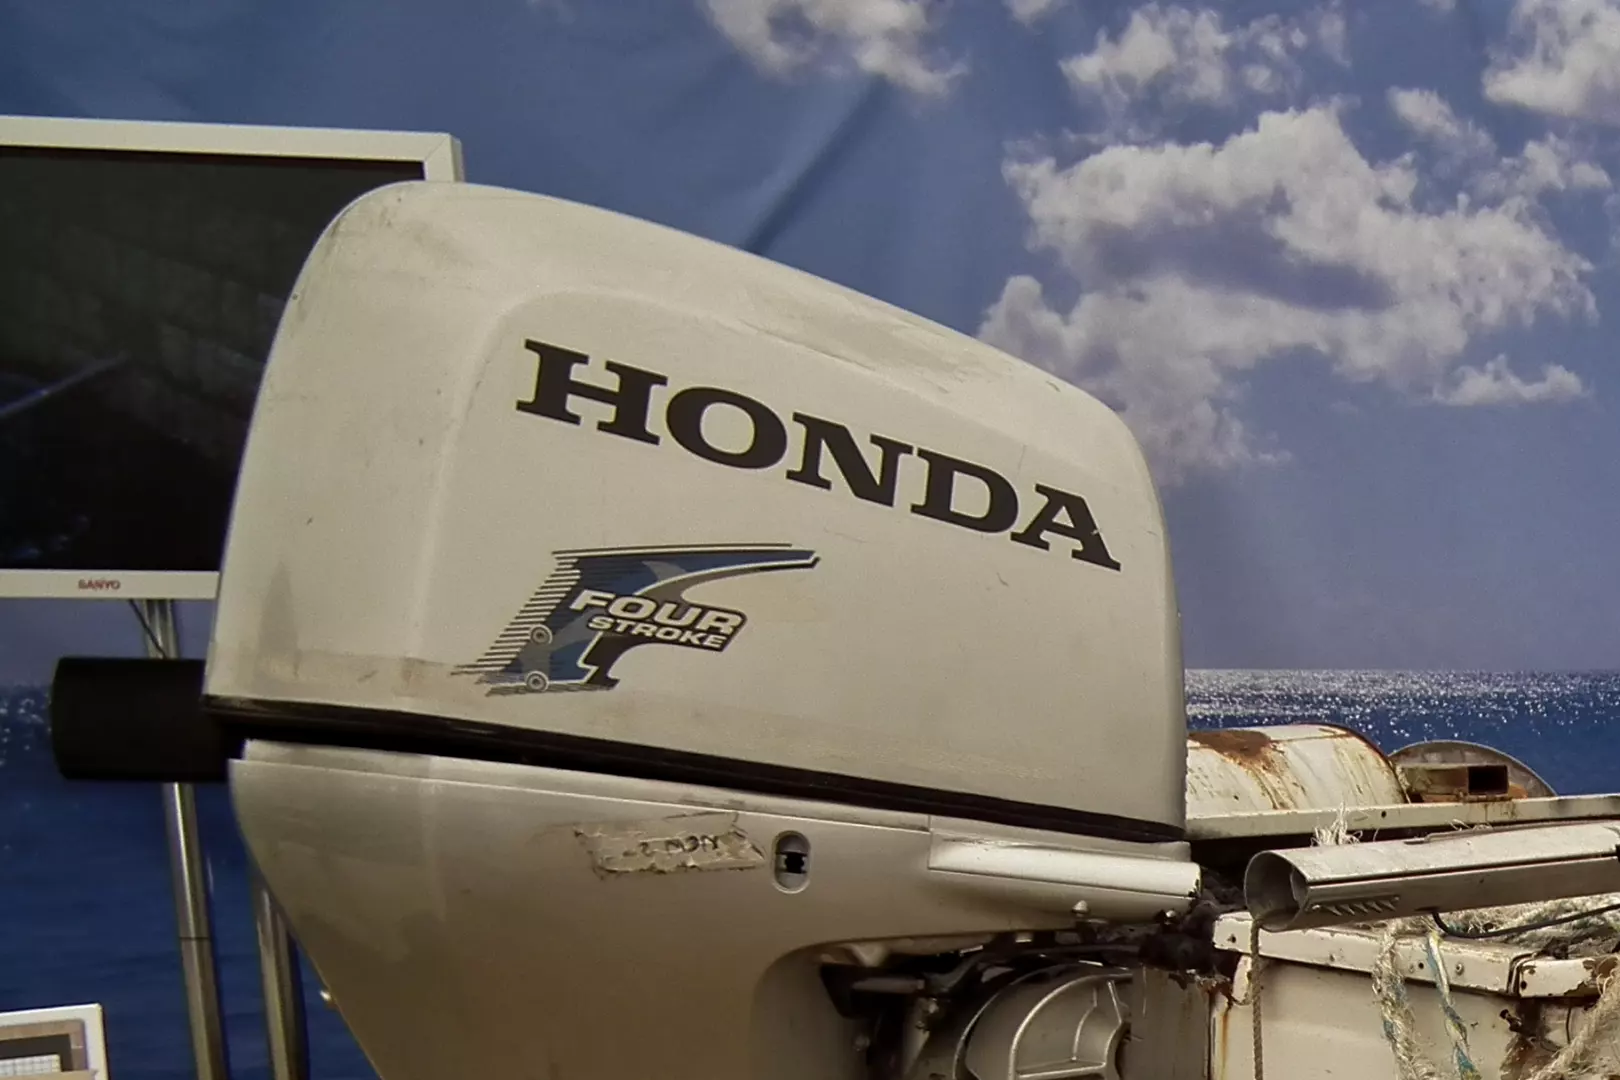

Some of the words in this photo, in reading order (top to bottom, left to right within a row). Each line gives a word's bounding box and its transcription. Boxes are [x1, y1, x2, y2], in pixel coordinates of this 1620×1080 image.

[515, 337, 1122, 572] HONDA
[569, 588, 744, 635] FOUR
[587, 615, 727, 649] STROKE
